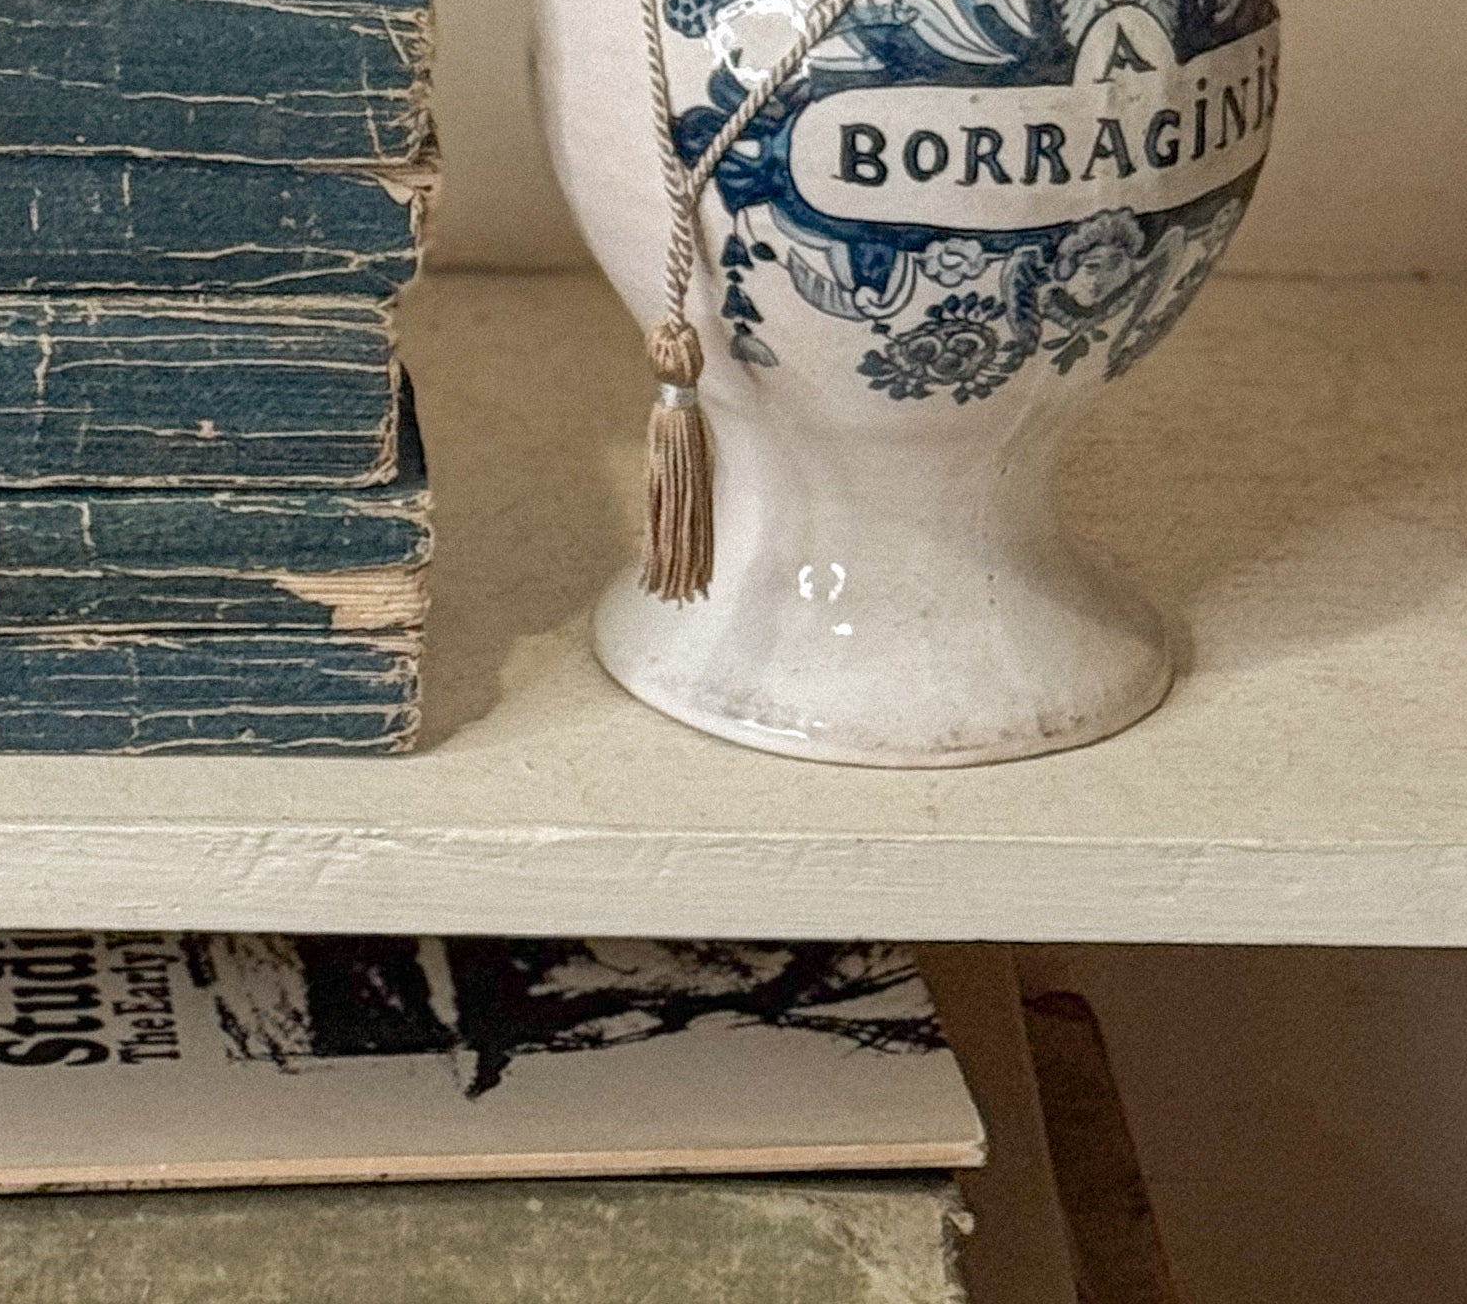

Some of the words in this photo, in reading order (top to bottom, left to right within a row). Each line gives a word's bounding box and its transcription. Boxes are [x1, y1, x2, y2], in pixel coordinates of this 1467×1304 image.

[1095, 22, 1159, 84] A
[109, 950, 180, 1016] Early
[117, 1017, 182, 1066] The
